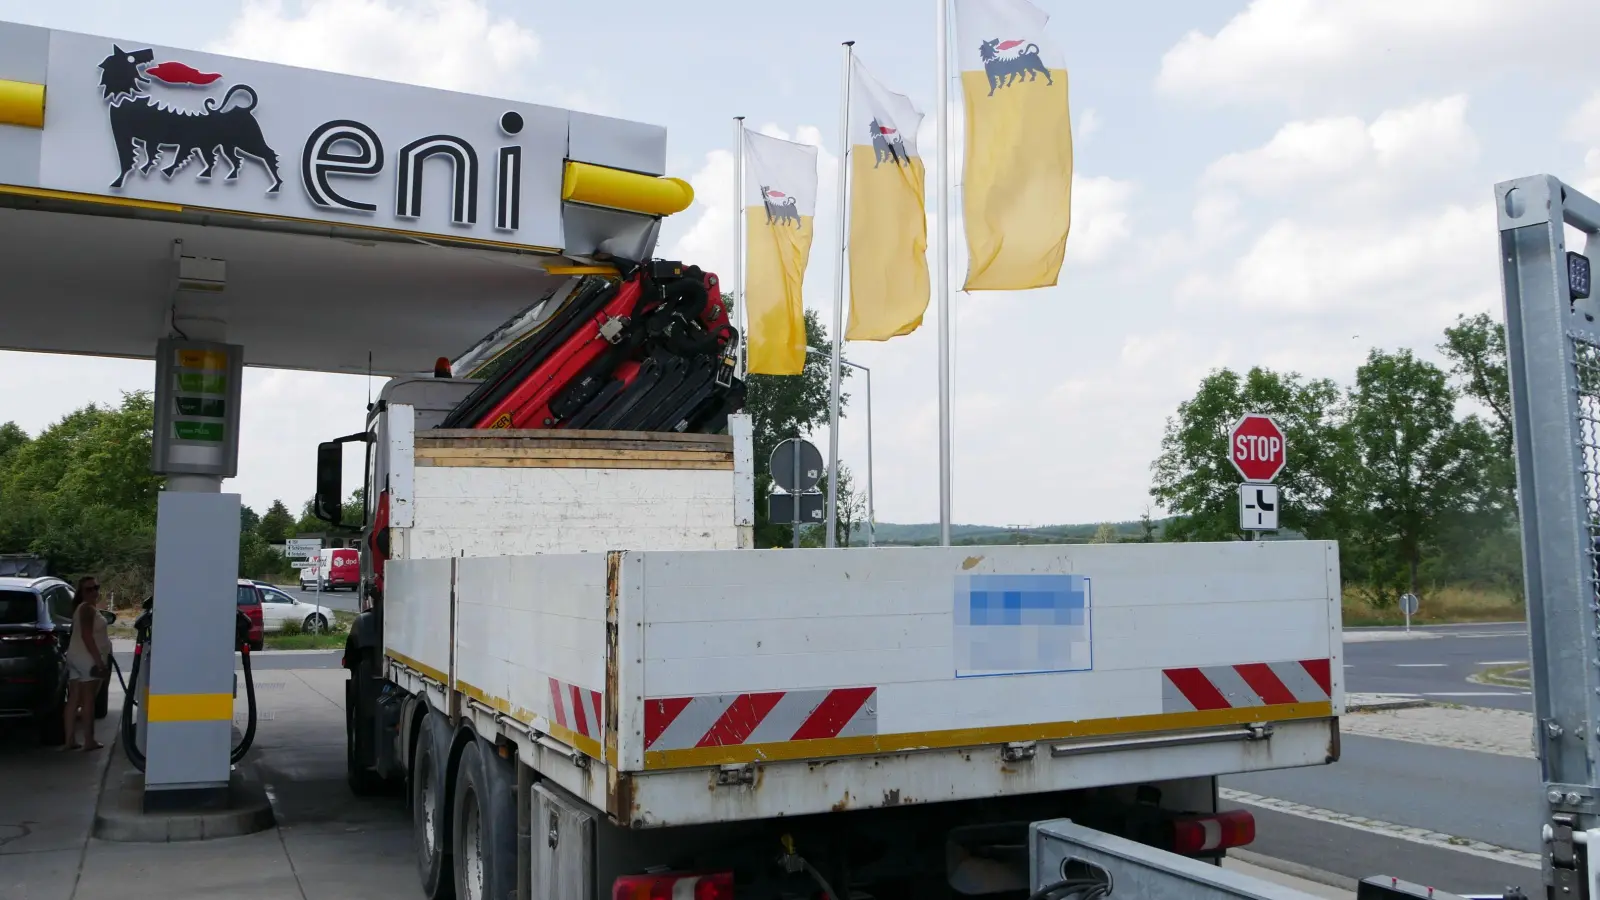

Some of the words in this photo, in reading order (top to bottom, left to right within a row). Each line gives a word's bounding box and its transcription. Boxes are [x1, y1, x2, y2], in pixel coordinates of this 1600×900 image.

[302, 110, 524, 230] eni
[1236, 434, 1280, 462] STOP
[345, 558, 357, 566] dpd
